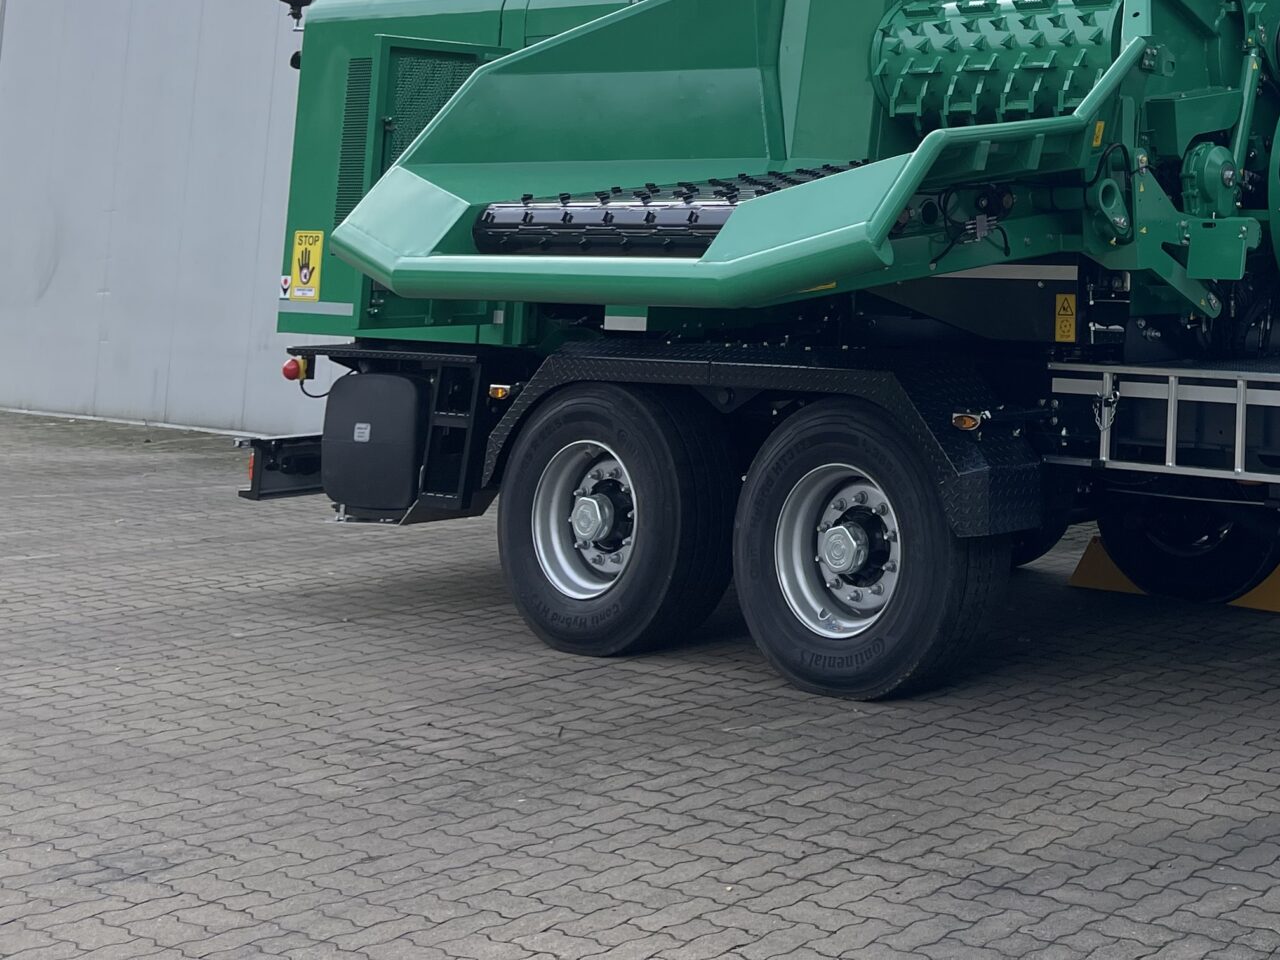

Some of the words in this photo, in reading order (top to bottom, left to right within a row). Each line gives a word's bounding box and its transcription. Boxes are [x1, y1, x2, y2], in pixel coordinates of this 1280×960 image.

[298, 234, 320, 246] STOP
[550, 612, 588, 629] Hybrid
[591, 604, 620, 627] Conti
[808, 638, 886, 671] Continental
